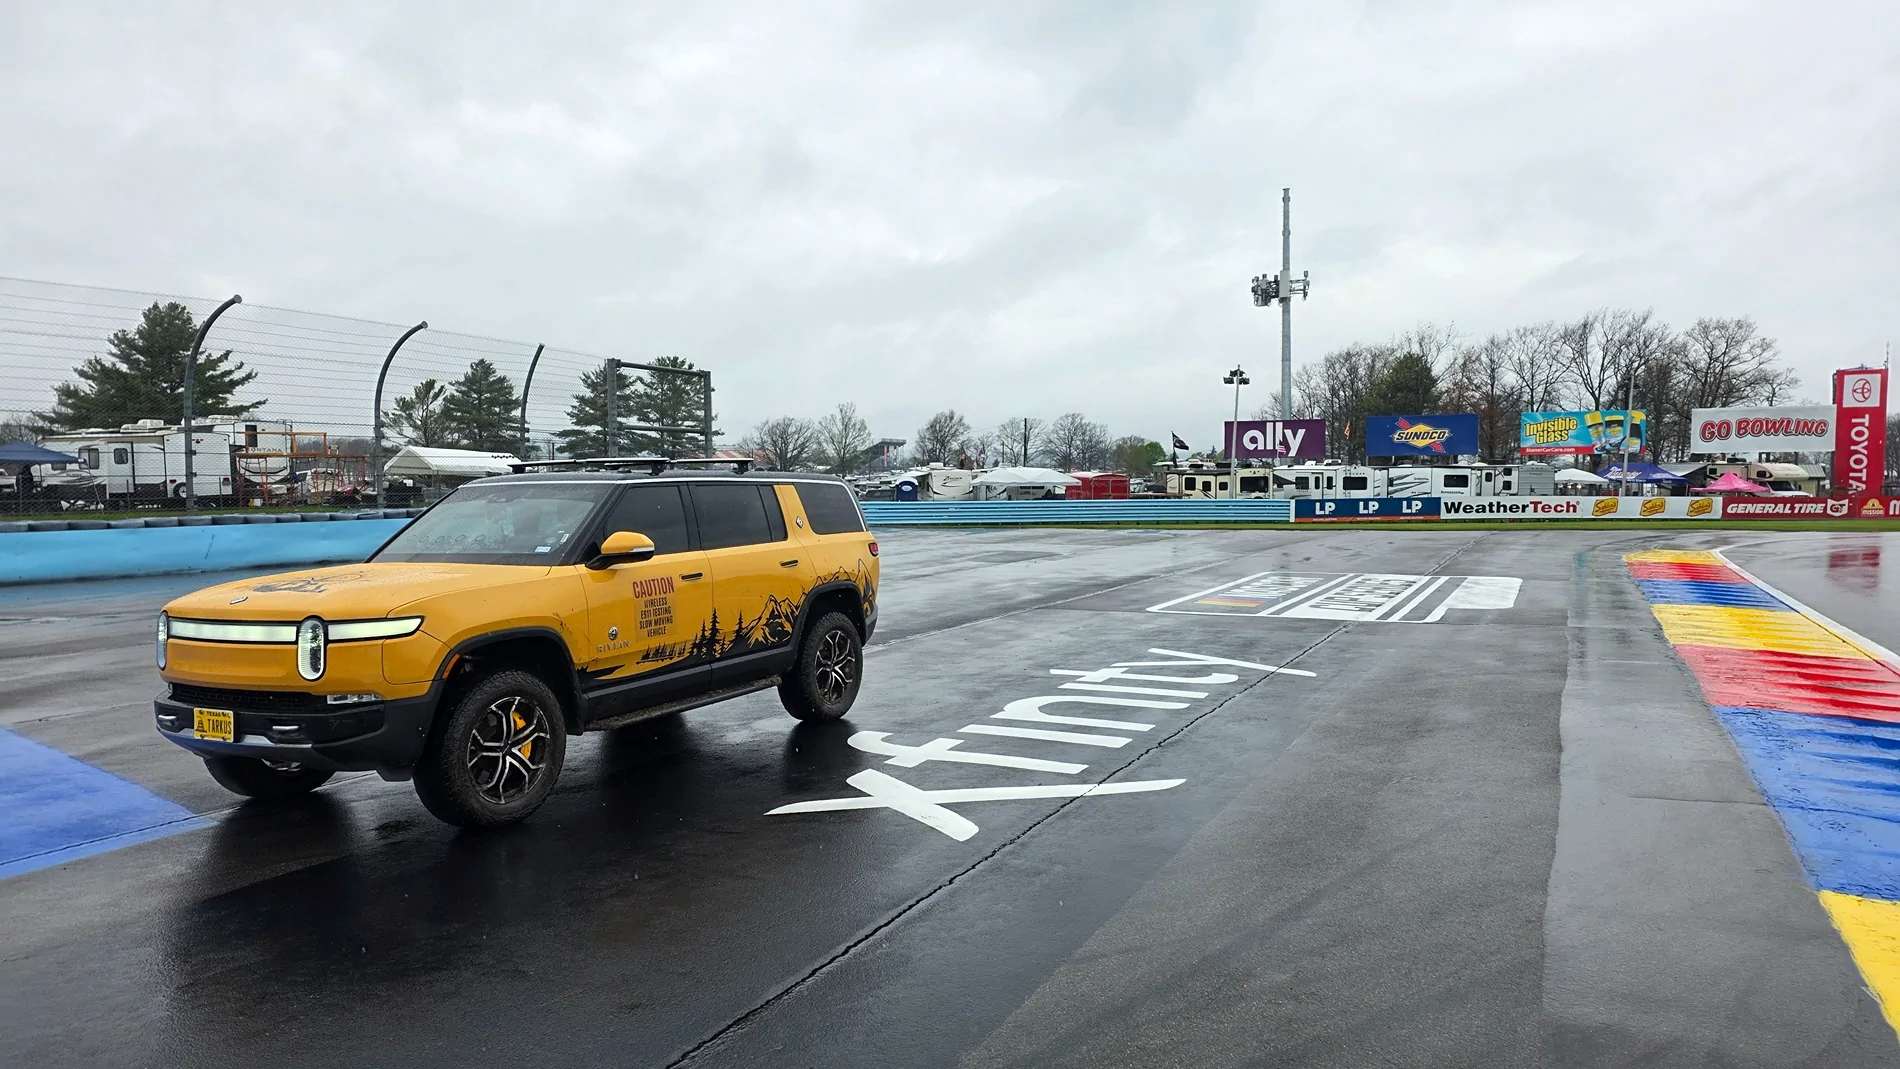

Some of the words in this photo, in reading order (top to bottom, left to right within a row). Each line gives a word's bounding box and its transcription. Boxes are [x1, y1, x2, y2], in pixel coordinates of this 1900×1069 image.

[1525, 417, 1578, 437] Invisible
[1700, 420, 1732, 442] GO
[1735, 418, 1829, 437] BOWLING
[1242, 422, 1306, 457] ally
[1394, 430, 1447, 442] SUNOCO
[1535, 430, 1569, 445] Glass
[1848, 413, 1870, 494] TOYOTA
[1443, 501, 1578, 514] WeatherTech
[1726, 503, 1791, 514] GENERAL
[1792, 503, 1826, 514] TIRE
[632, 576, 675, 600] CAUTION
[644, 597, 668, 609] WIRELESS
[640, 608, 652, 620] E911
[652, 606, 672, 618] TESTING
[639, 619, 653, 630] SLOW
[653, 615, 673, 627] MOVING
[647, 626, 667, 638] VEHICLE
[597, 639, 631, 653] RIVIAN
[207, 718, 232, 734] TARKUS
